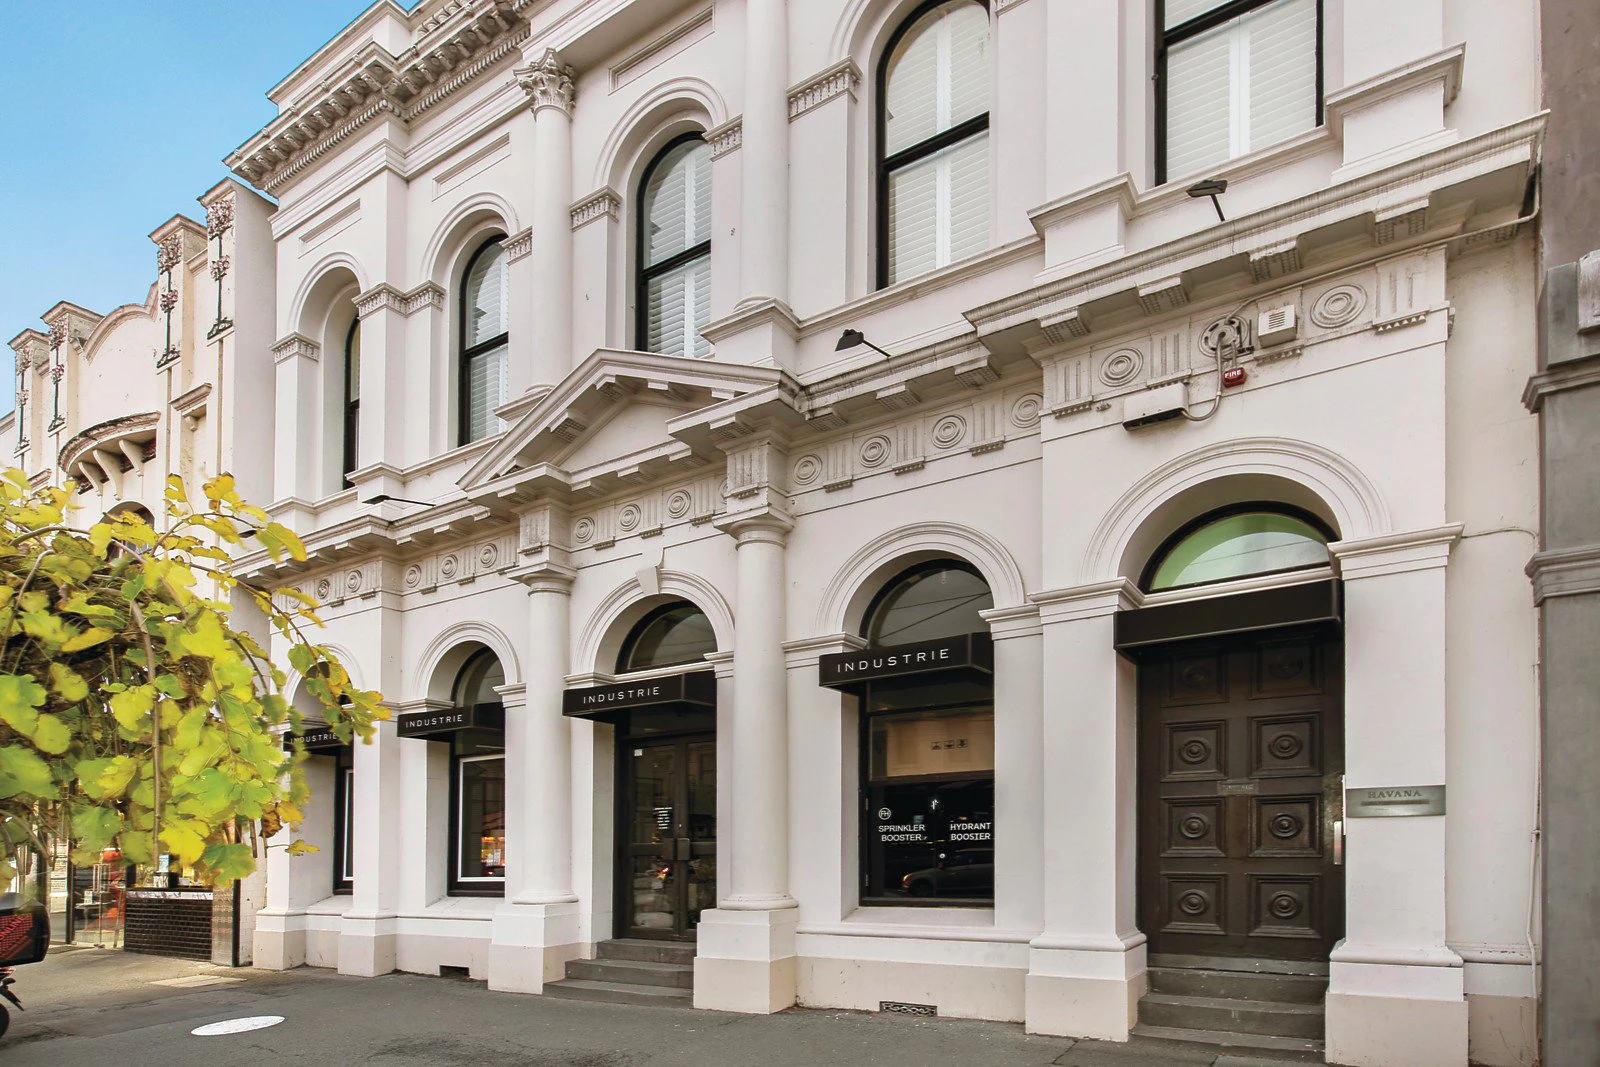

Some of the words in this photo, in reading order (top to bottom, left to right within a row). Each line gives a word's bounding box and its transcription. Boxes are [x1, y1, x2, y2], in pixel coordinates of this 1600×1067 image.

[1224, 369, 1242, 378] FIRE
[837, 648, 949, 673] INDUSTRIE
[583, 686, 660, 704] INDUSTRIE
[405, 714, 463, 728] INDUSTRIE
[1368, 789, 1421, 798] HAVANA
[878, 824, 926, 833] SPRINKLER
[949, 822, 991, 831] HYDRANT
[881, 833, 922, 842] BOOSTER
[950, 832, 991, 841] BOOSTER
